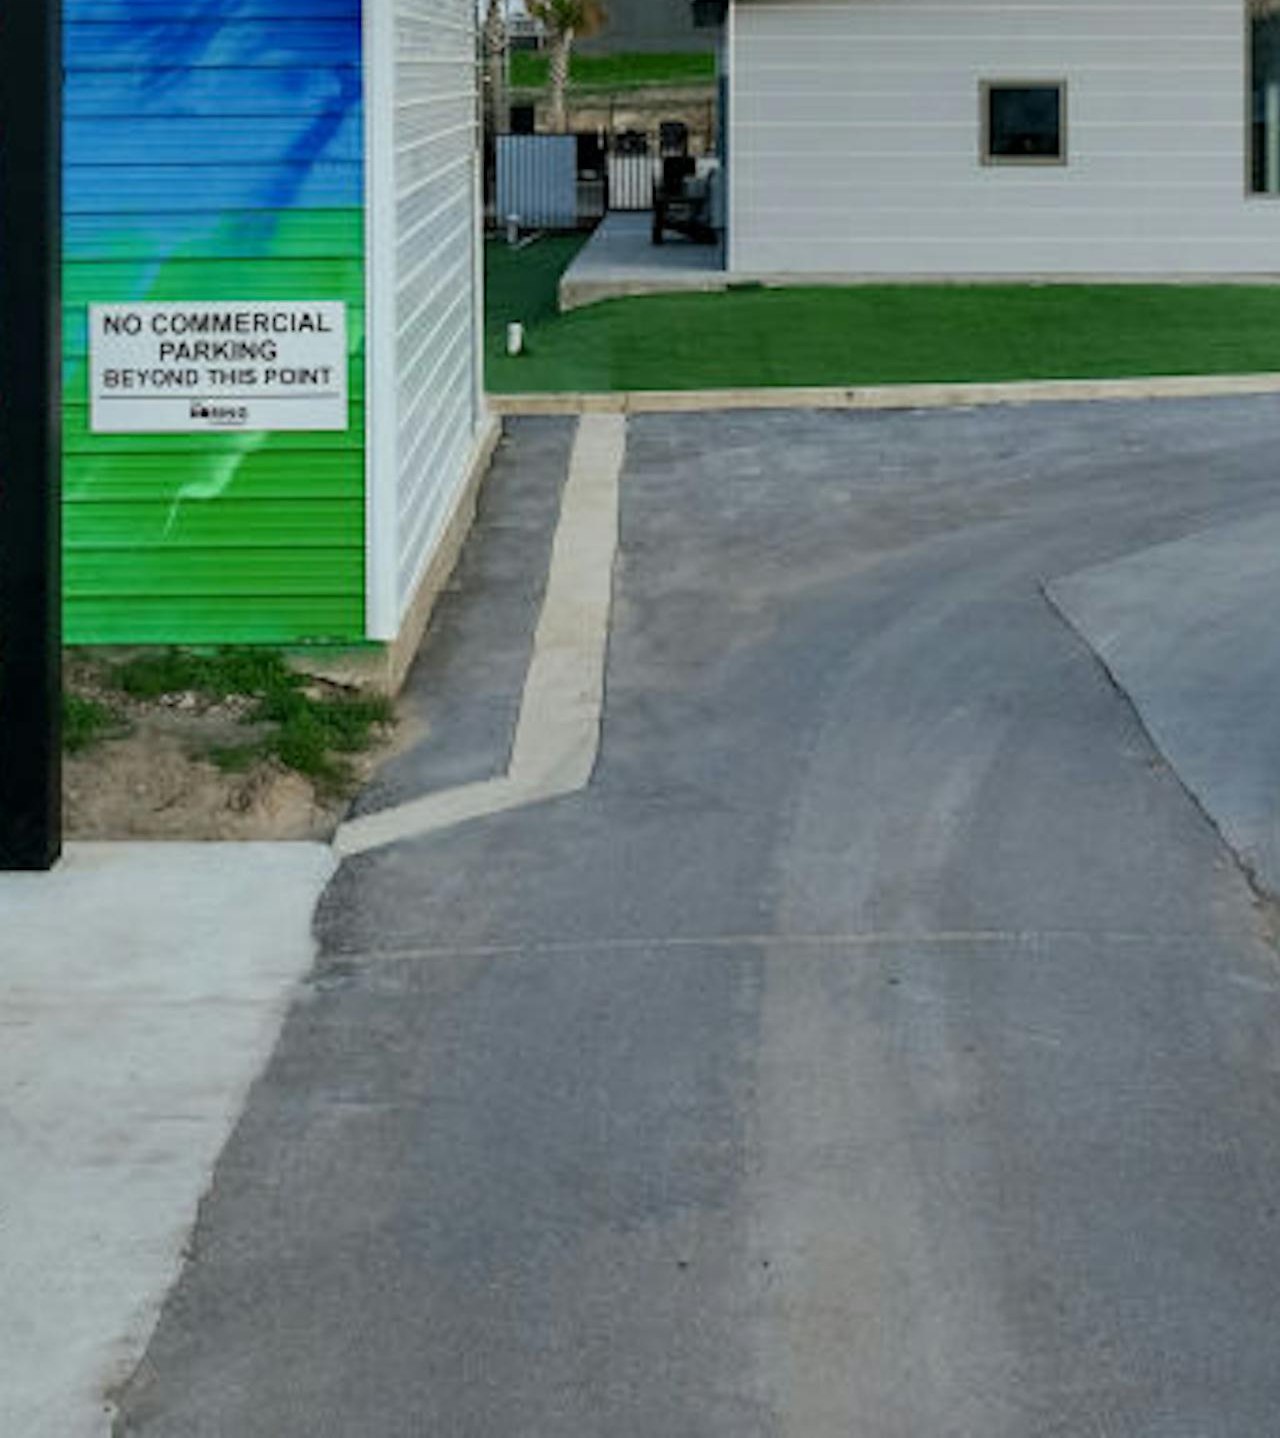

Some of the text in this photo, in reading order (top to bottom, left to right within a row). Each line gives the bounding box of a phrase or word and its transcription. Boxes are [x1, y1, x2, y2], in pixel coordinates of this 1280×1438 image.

[103, 312, 332, 335] NO COMMERCIAL
[159, 339, 278, 362] PARKING
[103, 367, 332, 388] BEYOND THIS POINT
